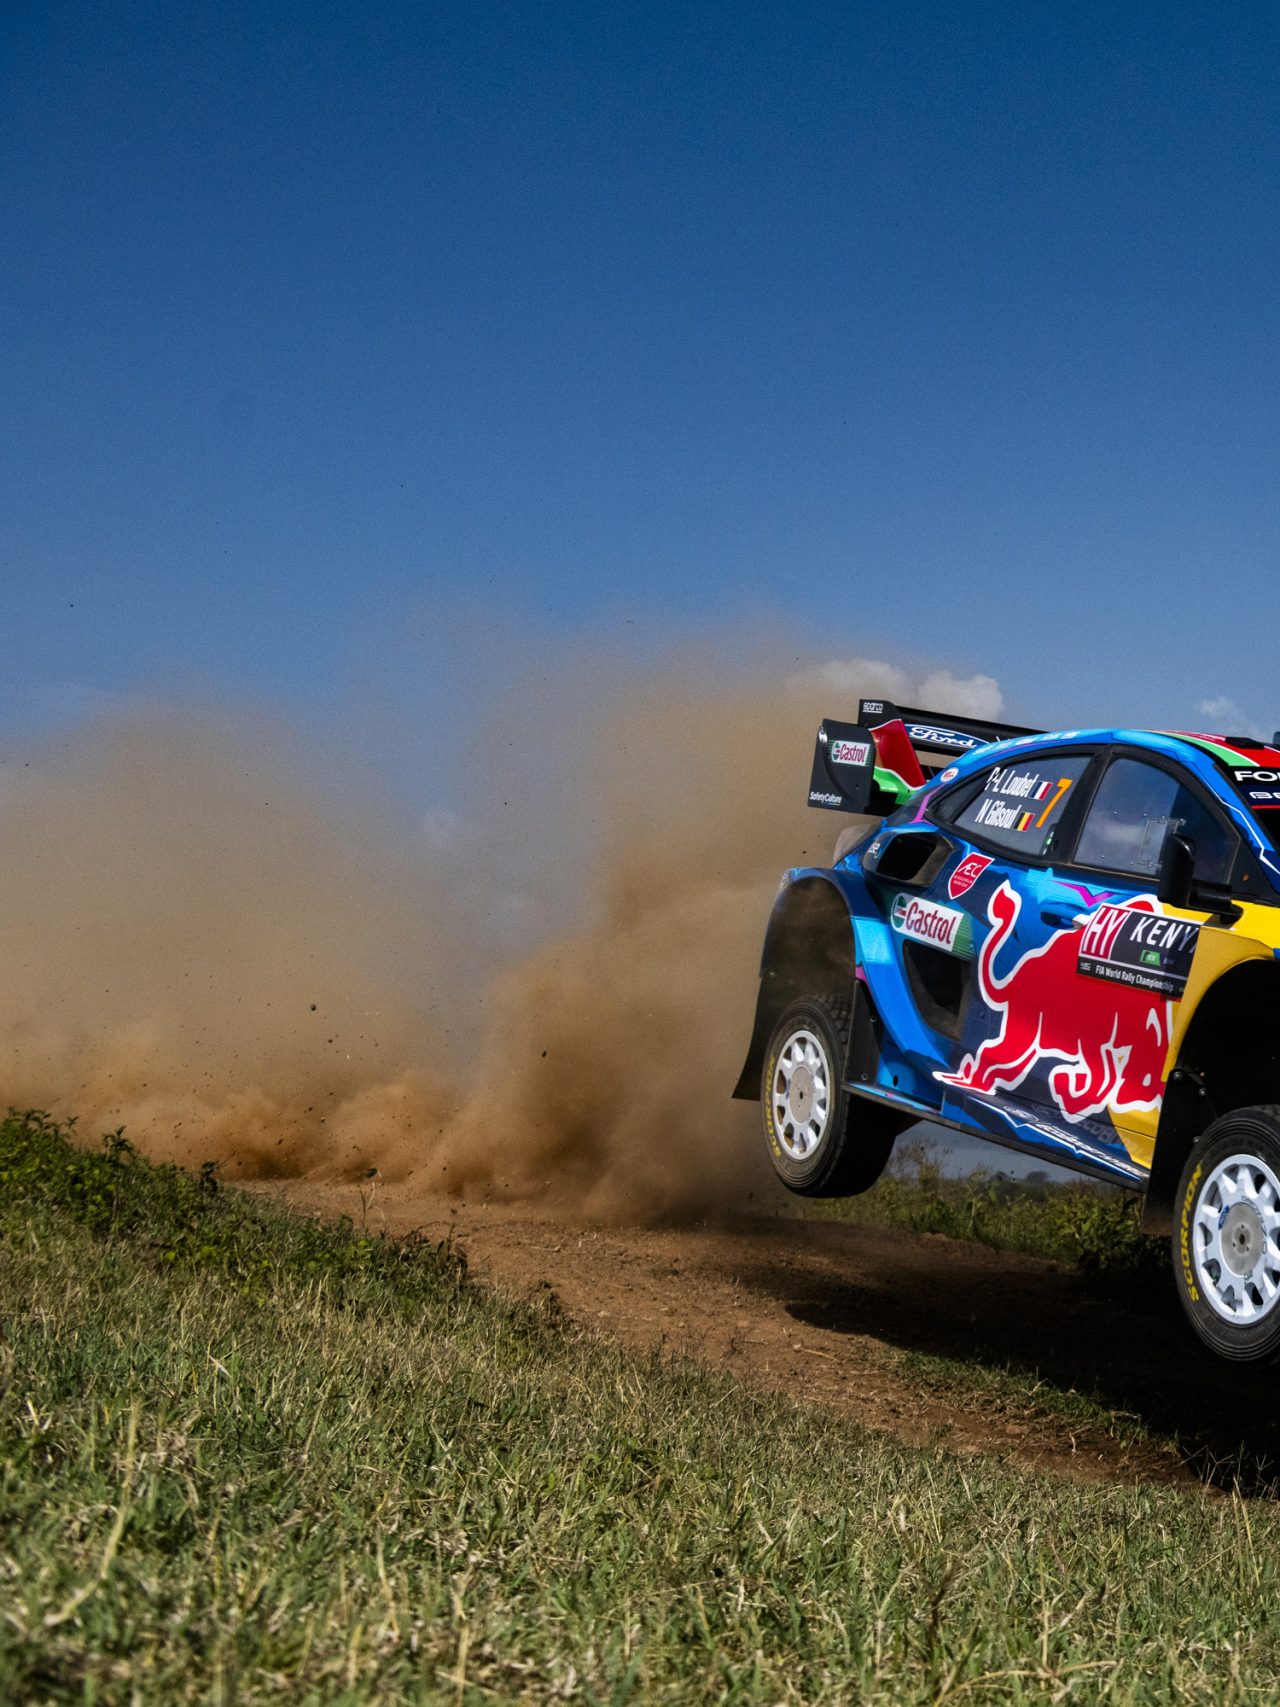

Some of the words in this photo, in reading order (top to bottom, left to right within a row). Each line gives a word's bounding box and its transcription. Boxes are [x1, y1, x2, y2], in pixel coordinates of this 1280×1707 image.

[862, 702, 884, 712] sparco
[909, 726, 977, 748] Ford
[840, 744, 867, 762] Castrol
[1000, 769, 1040, 798] Loubet
[974, 799, 993, 823] N
[1036, 777, 1073, 829] 7
[905, 901, 958, 946] Castrol
[1095, 965, 1107, 975] FIA
[1105, 967, 1121, 979] World
[1121, 971, 1136, 985] Rally
[1136, 974, 1174, 993] Championship
[1180, 1160, 1203, 1301] SCORPION
